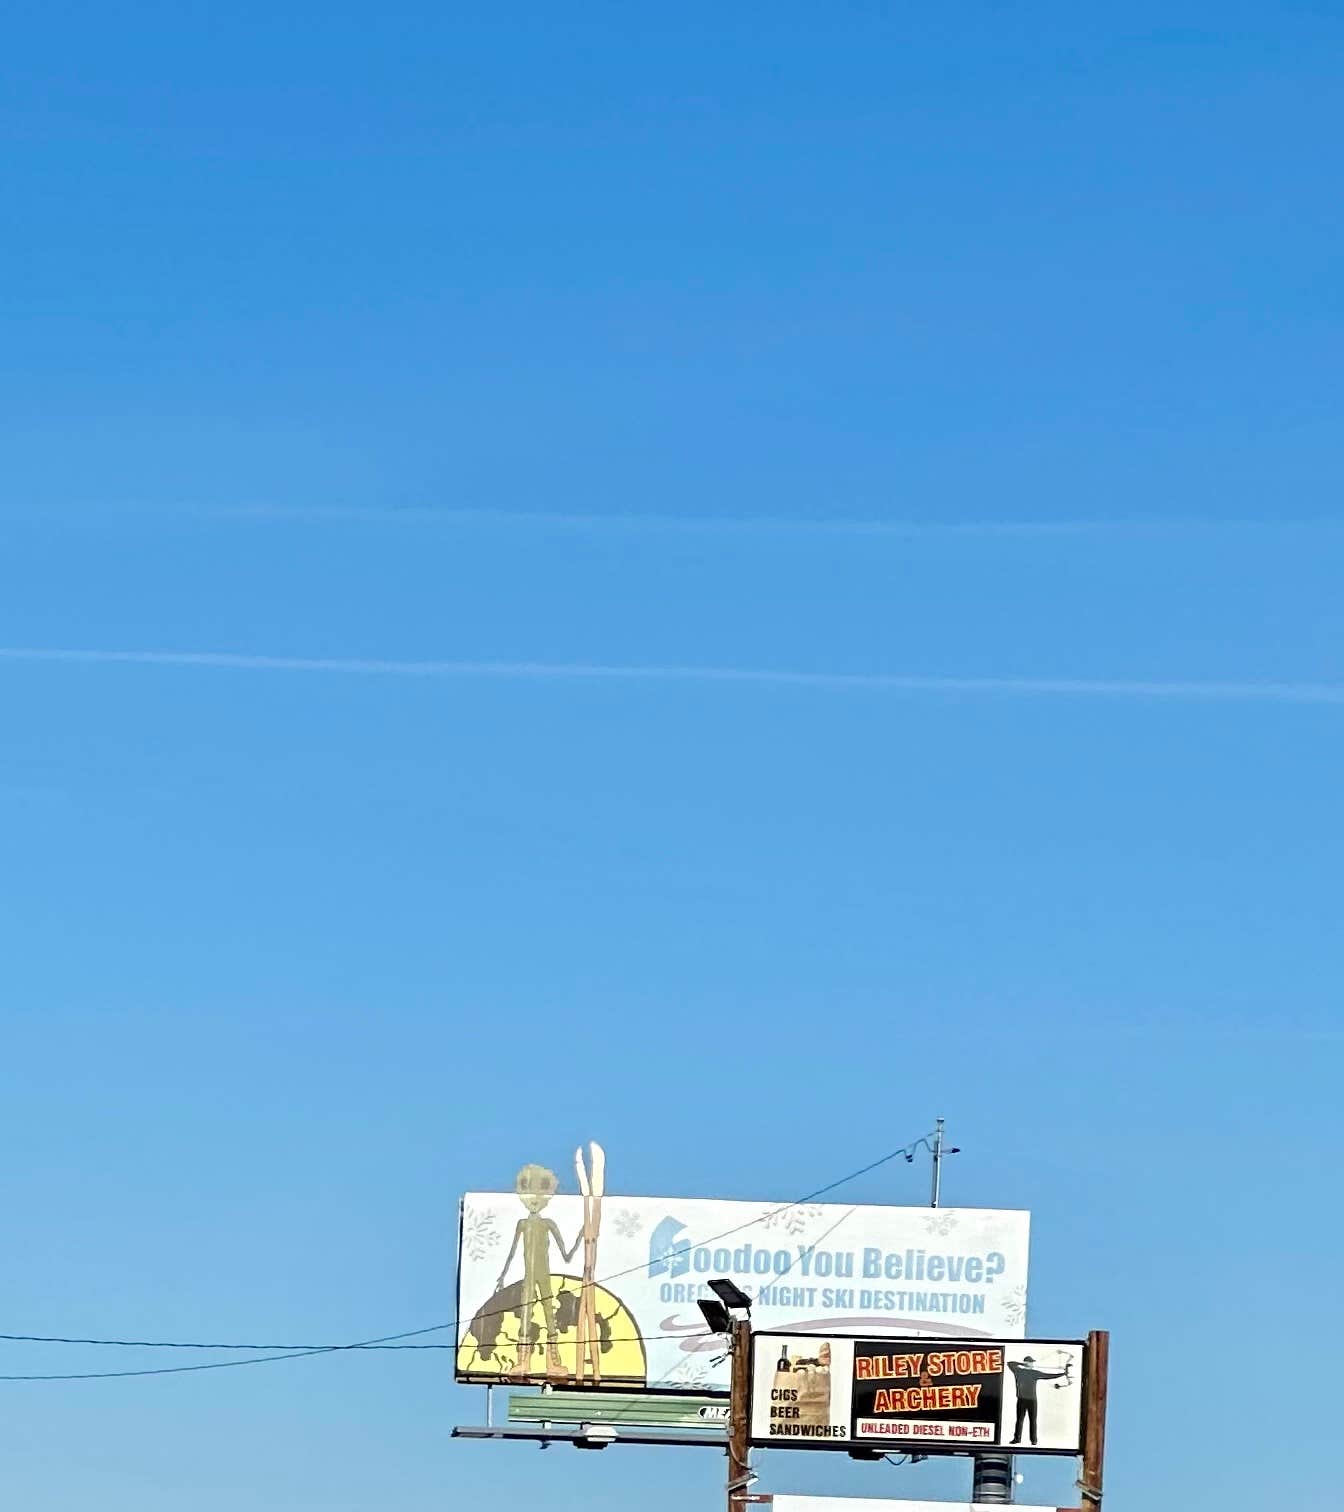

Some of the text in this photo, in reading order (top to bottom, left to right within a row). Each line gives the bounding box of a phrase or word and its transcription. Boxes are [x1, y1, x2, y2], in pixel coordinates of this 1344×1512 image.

[797, 1247, 854, 1278] You
[863, 1249, 1005, 1283] Believe?
[759, 1285, 817, 1308] NIGHT
[822, 1288, 855, 1309] SKI
[861, 1290, 986, 1314] DESTINATION
[856, 1350, 1002, 1379] RILEY STORE
[771, 1388, 798, 1402] CIGS
[874, 1384, 982, 1413] ARCHERY
[770, 1406, 800, 1419] BEER
[769, 1423, 846, 1438] SANDWICHES
[861, 1422, 990, 1438] UNLEADED DIESEL NON-ETH
